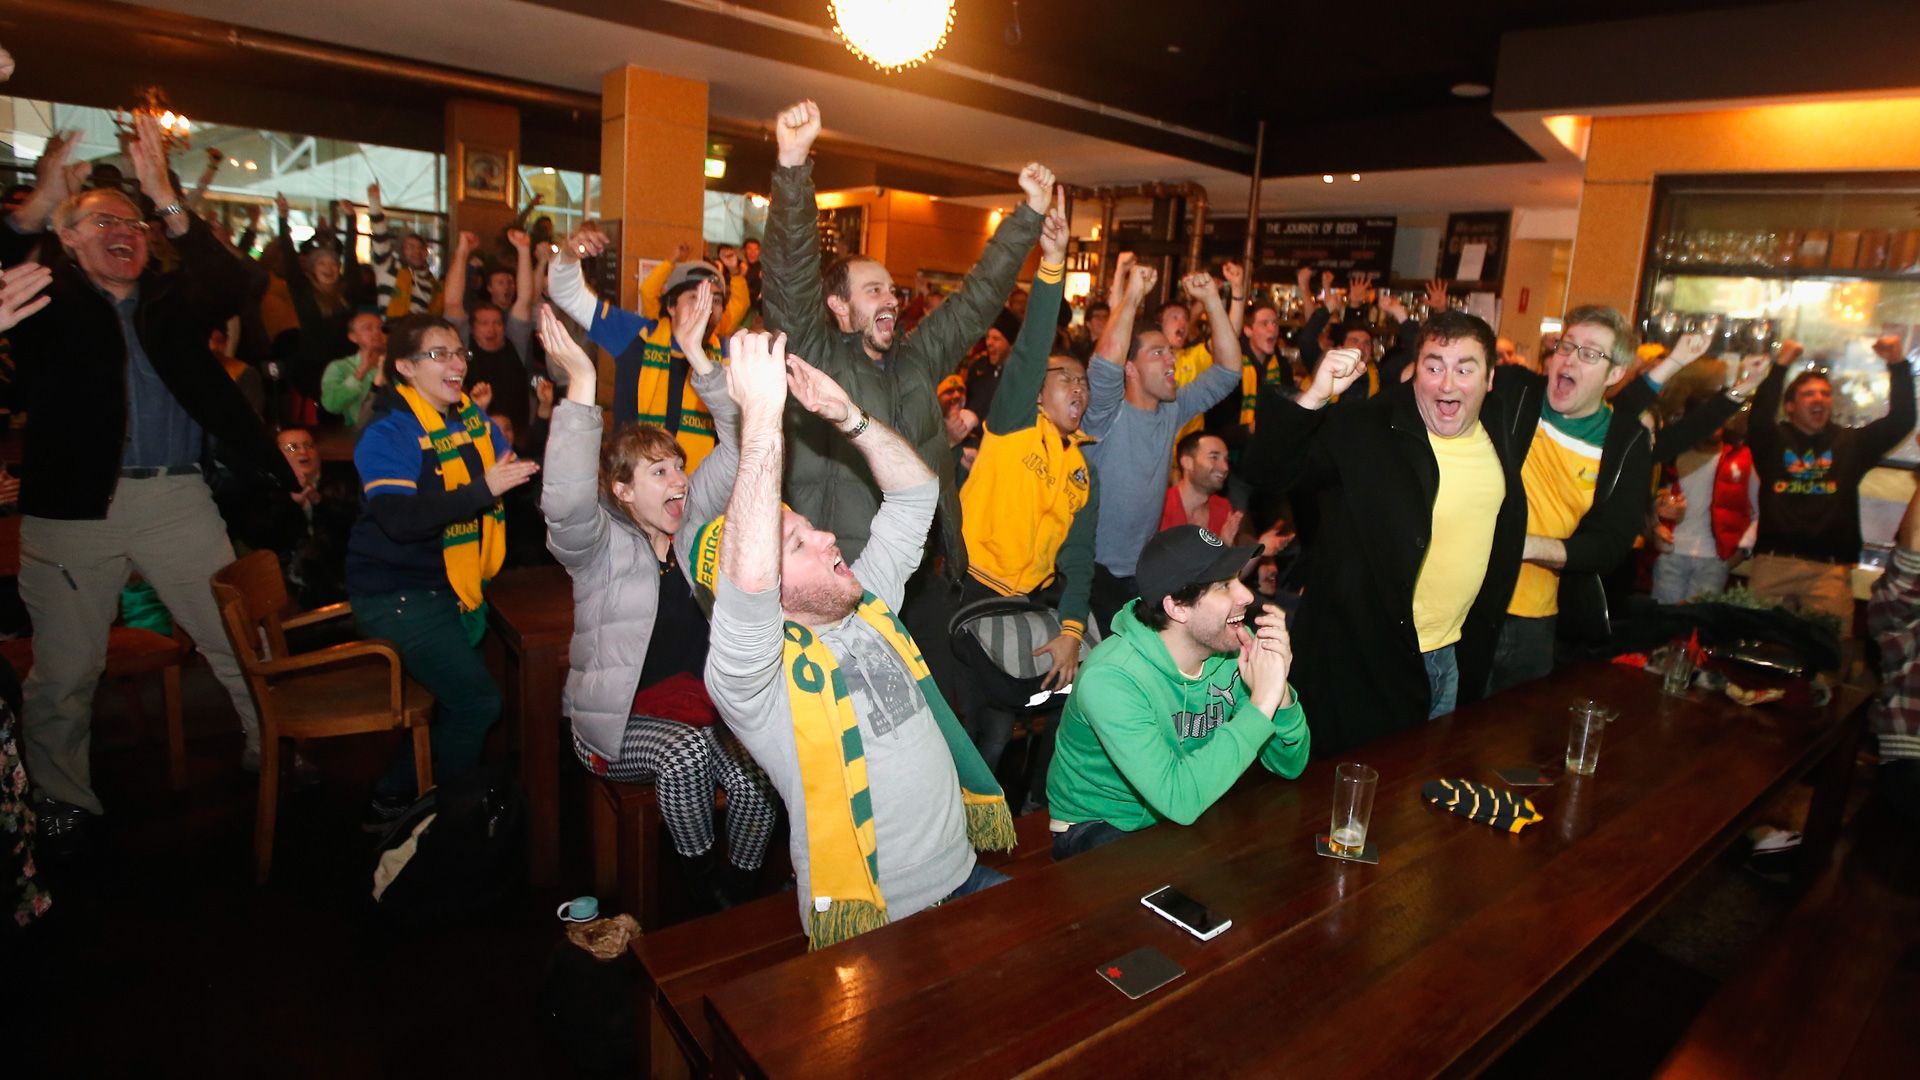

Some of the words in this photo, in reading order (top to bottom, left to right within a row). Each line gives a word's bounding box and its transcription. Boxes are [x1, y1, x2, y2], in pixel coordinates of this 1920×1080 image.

[1266, 222, 1281, 234] THE
[1283, 222, 1319, 234] JOURNEY
[1322, 222, 1334, 234] OF
[1335, 222, 1358, 234] BEER
